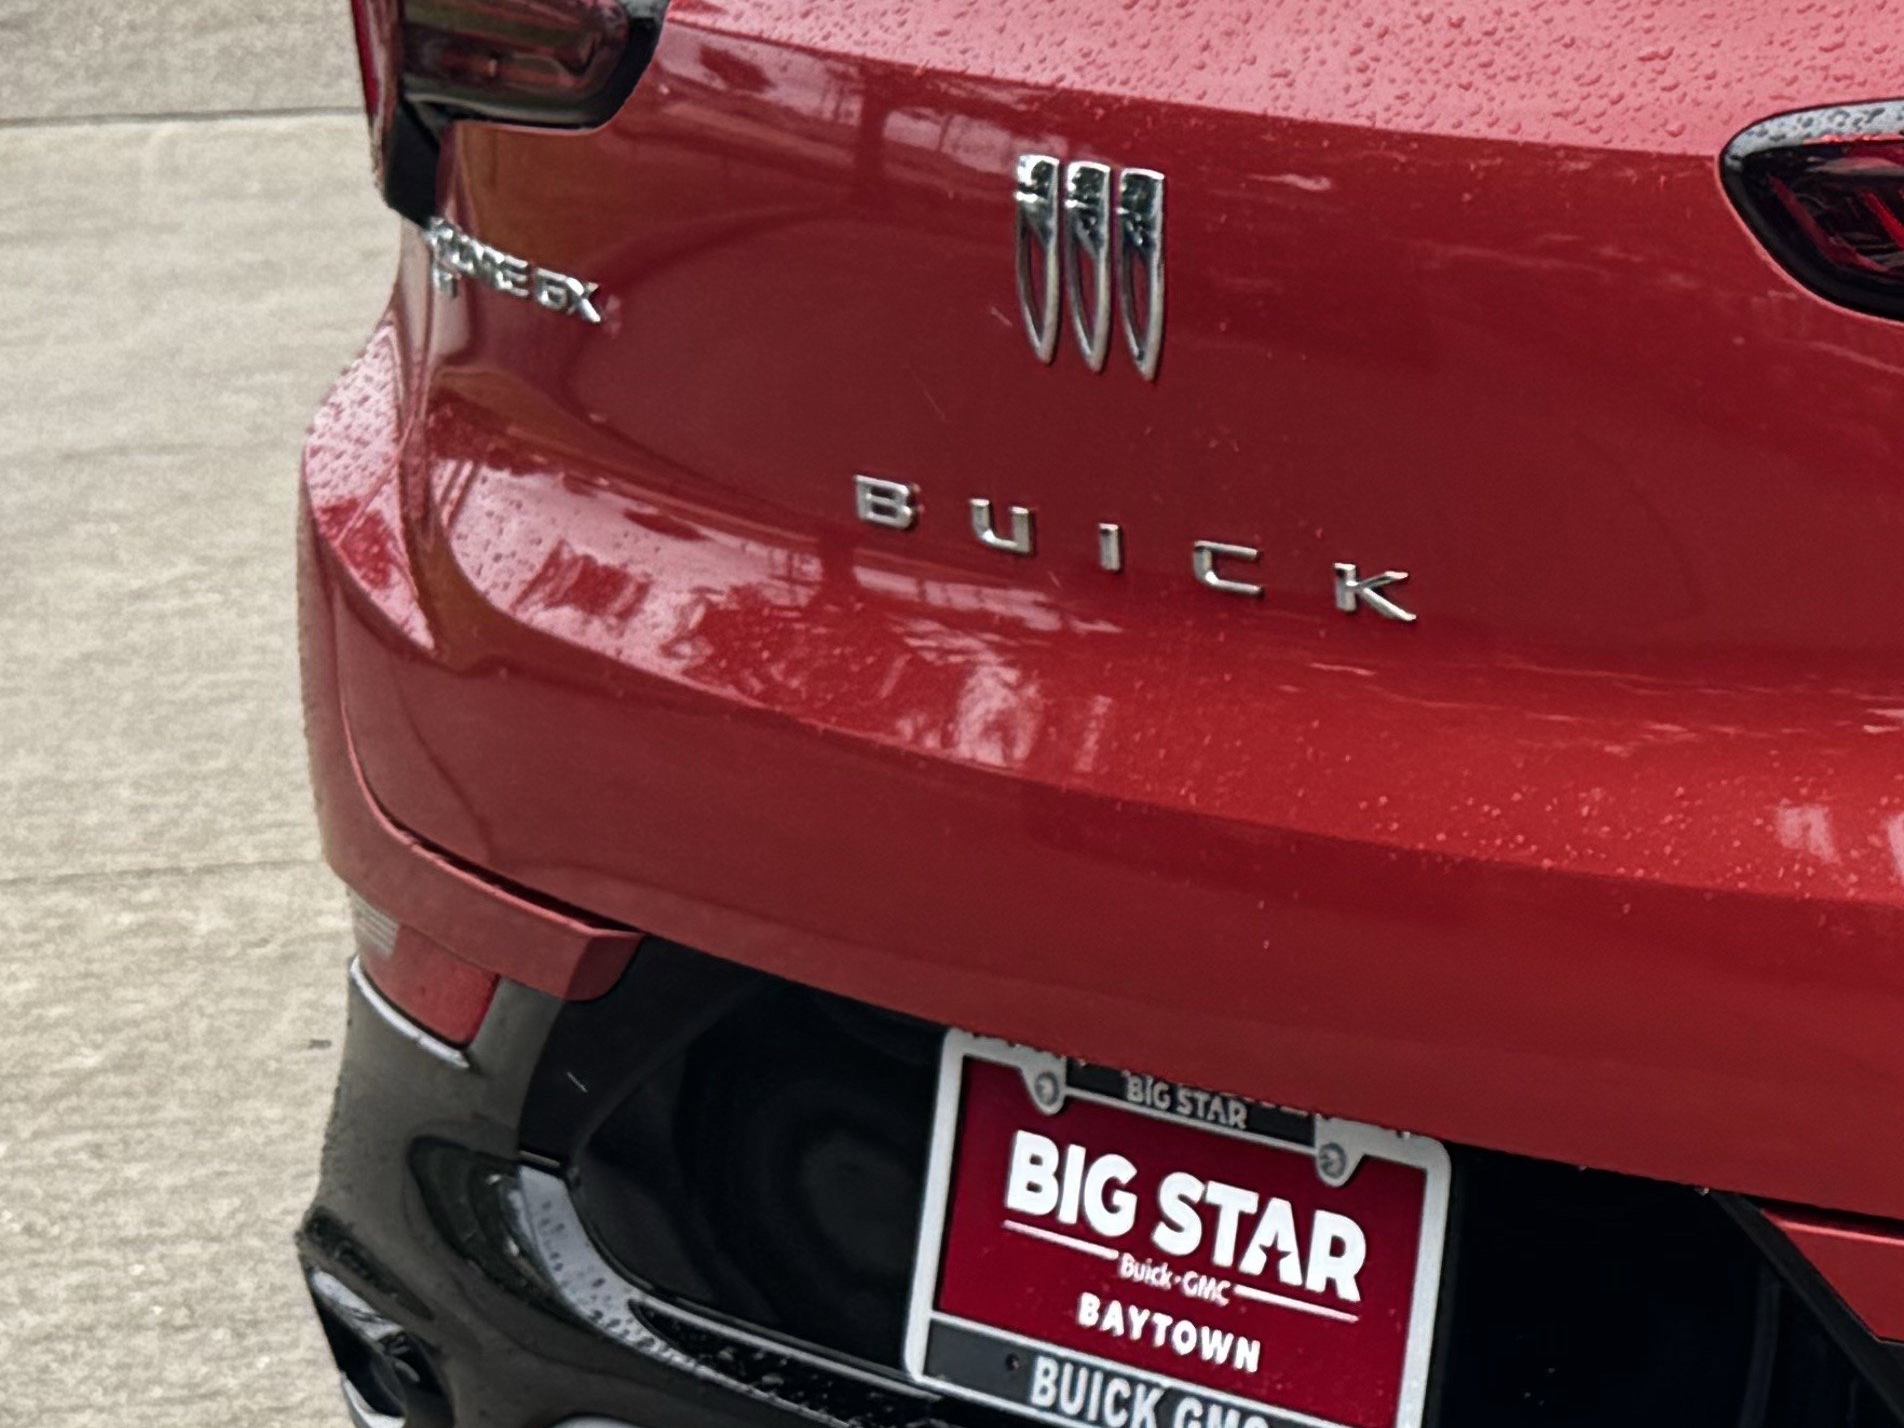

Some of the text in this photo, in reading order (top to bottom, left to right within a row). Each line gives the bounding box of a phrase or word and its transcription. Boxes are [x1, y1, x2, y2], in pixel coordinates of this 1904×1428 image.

[536, 267, 601, 322] GX
[854, 473, 1417, 622] BUICK
[1126, 1075, 1248, 1129] BIG STAR
[1004, 1130, 1367, 1302] BIG STAR
[1078, 1291, 1261, 1373] BAYTOWN
